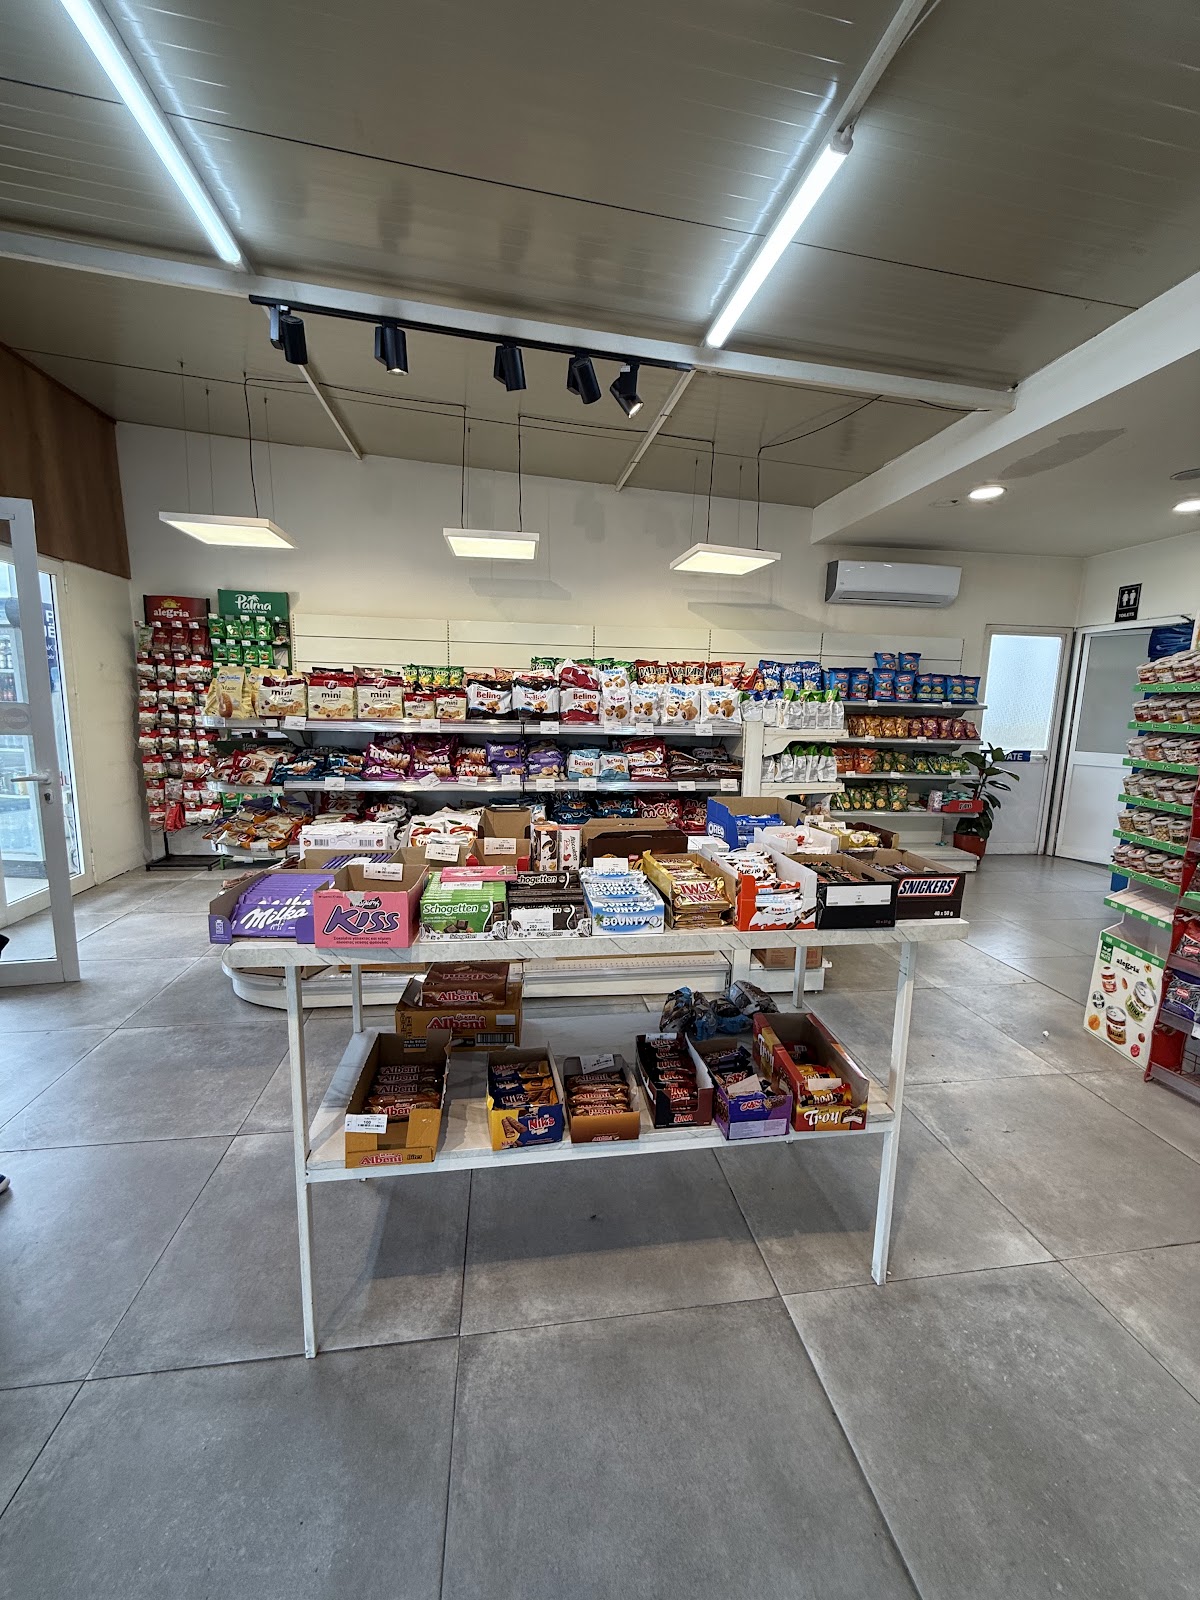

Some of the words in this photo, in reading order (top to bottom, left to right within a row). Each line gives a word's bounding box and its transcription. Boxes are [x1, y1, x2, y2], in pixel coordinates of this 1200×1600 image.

[234, 594, 272, 610] Palma
[154, 608, 190, 618] alegria
[272, 688, 292, 696] mini
[322, 690, 342, 698] mini
[370, 690, 391, 698] mini
[476, 691, 502, 700] Belino
[573, 692, 597, 700] Belino
[708, 823, 725, 837] OREO
[680, 882, 712, 894] TWIX
[900, 880, 954, 895] SNICKERS
[423, 903, 478, 916] Schogetten
[240, 906, 308, 930] Milka
[602, 917, 647, 927] BOUNTY
[1116, 958, 1140, 974] alegria
[436, 992, 478, 1002] Albeni
[426, 1016, 487, 1029] Albeni
[382, 1065, 420, 1074] Albeni
[378, 1084, 418, 1094] Albeni
[378, 1106, 411, 1116] Alben
[804, 1110, 840, 1126] Troy
[360, 1154, 402, 1165] Albeni
